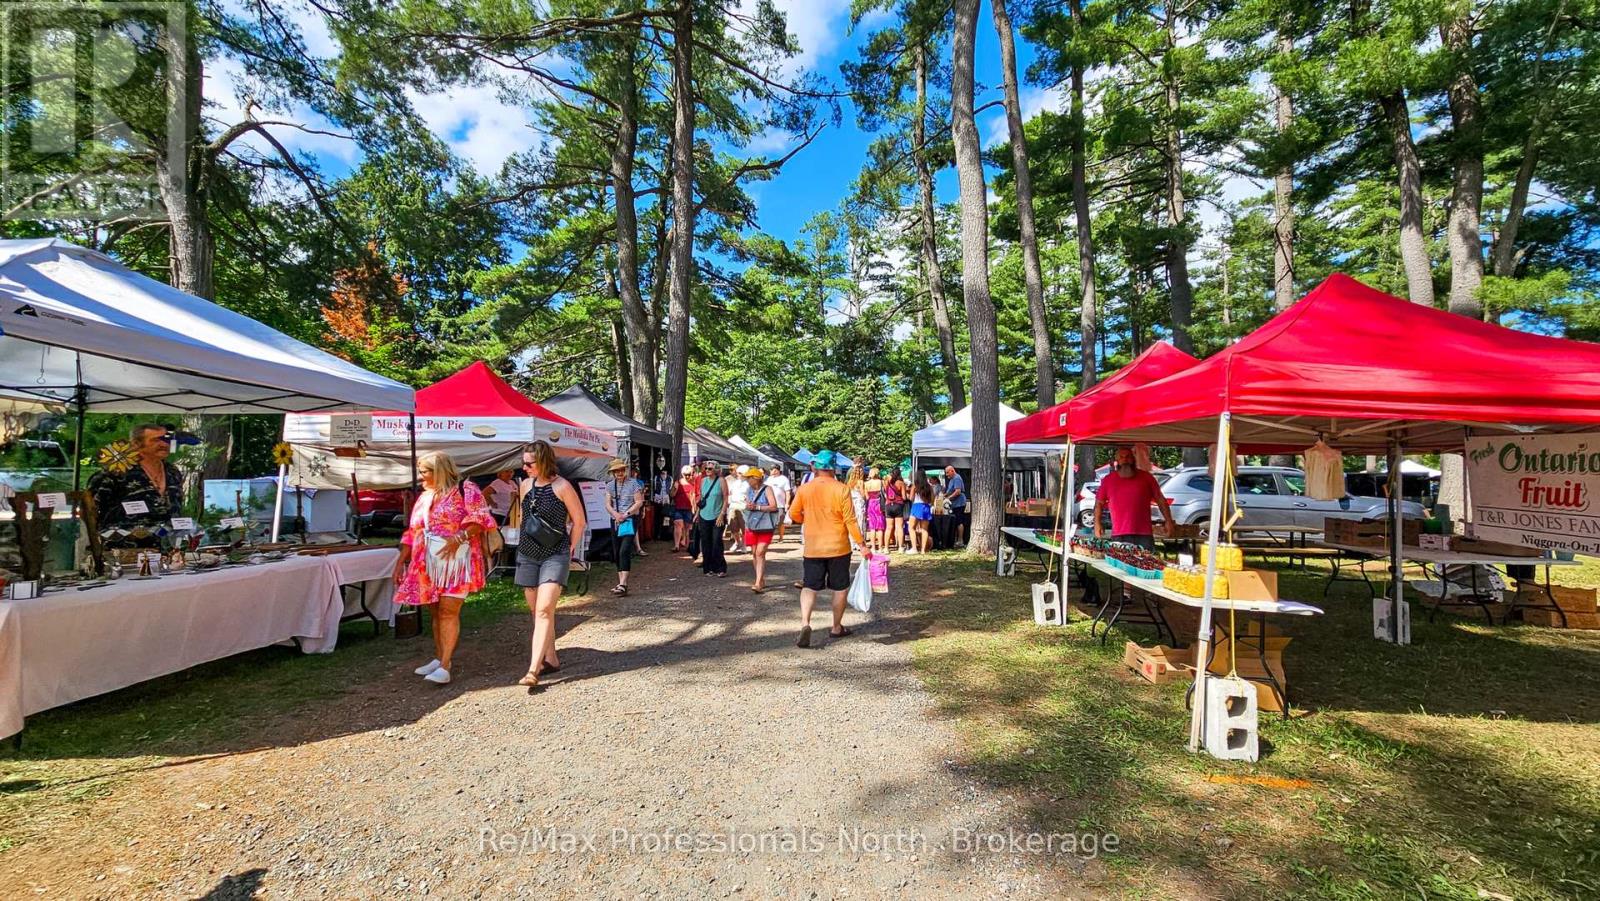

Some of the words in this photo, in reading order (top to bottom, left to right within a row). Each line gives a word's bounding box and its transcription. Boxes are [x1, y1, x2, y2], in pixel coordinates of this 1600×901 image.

[377, 419, 422, 429] Muskoa
[427, 419, 443, 430] Pot
[447, 419, 465, 430] Pie
[1499, 443, 1600, 474] Ontario
[1519, 477, 1586, 509] Fruit
[1477, 509, 1506, 524] T&R
[1512, 513, 1563, 531] JONES
